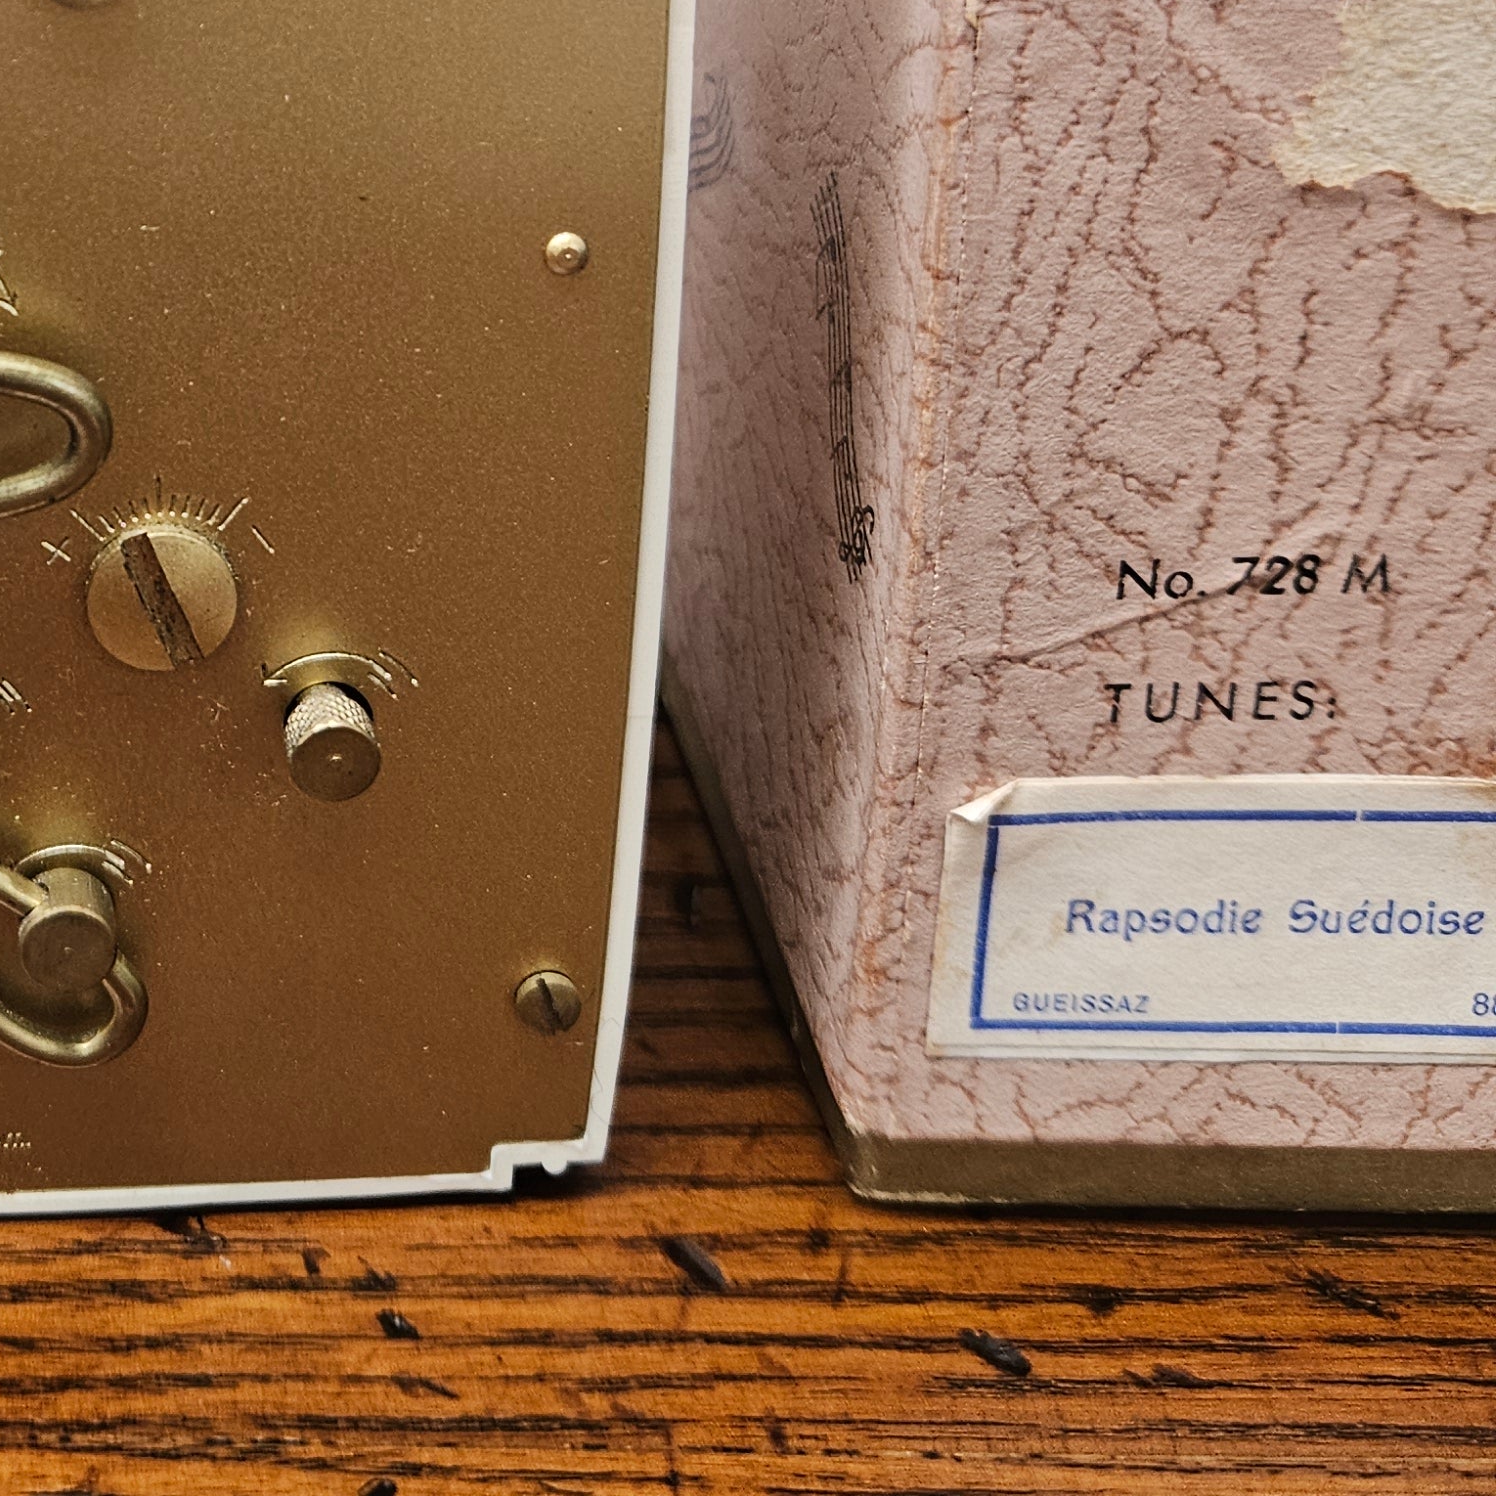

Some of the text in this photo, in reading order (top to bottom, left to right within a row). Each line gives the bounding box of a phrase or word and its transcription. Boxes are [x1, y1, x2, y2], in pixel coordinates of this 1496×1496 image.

[1115, 553, 1391, 601] No. 728 M
[1103, 680, 1337, 724] TUNES:
[1064, 898, 1485, 941] Rapsodie Suédoise
[1012, 992, 1150, 1014] GUEISSAZ
[1471, 992, 1496, 1016] 8
